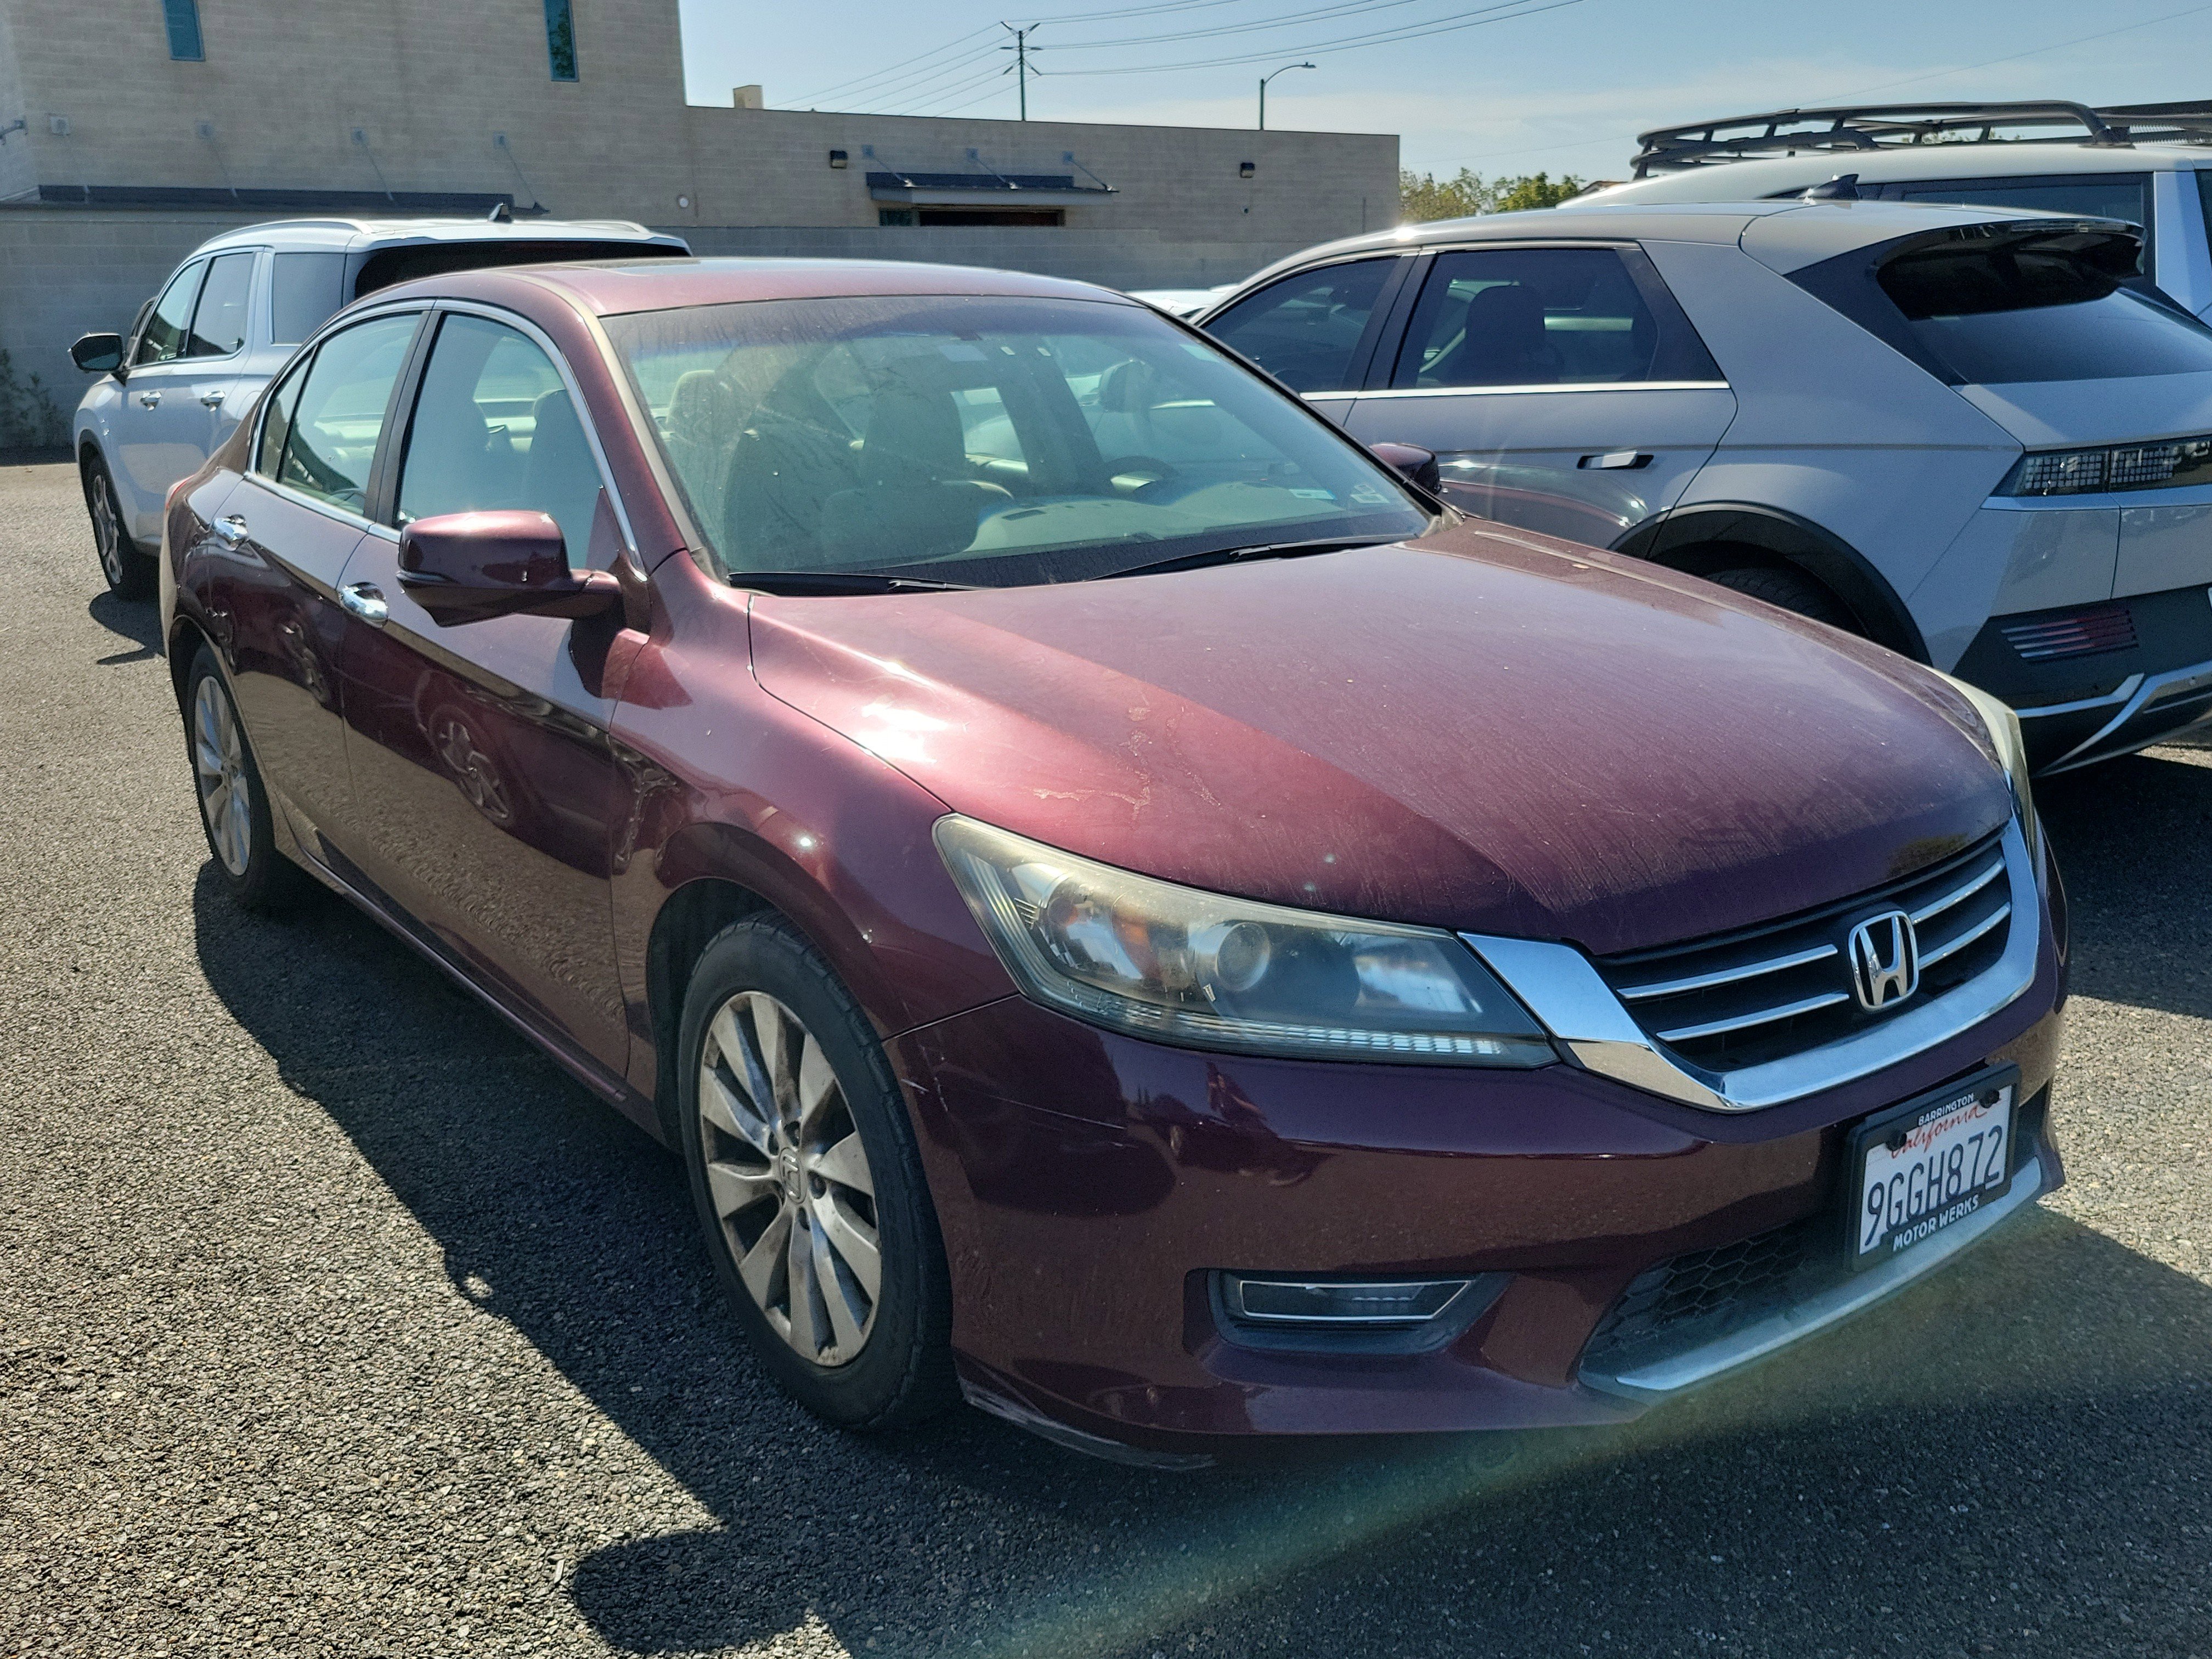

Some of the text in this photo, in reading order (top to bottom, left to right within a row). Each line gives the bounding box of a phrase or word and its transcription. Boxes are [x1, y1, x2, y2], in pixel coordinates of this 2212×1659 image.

[1918, 1092, 1974, 1125] BARRINGTON
[1865, 1125, 2002, 1246] 9GGH872
[1893, 1194, 1979, 1251] MOTOR WERKS
